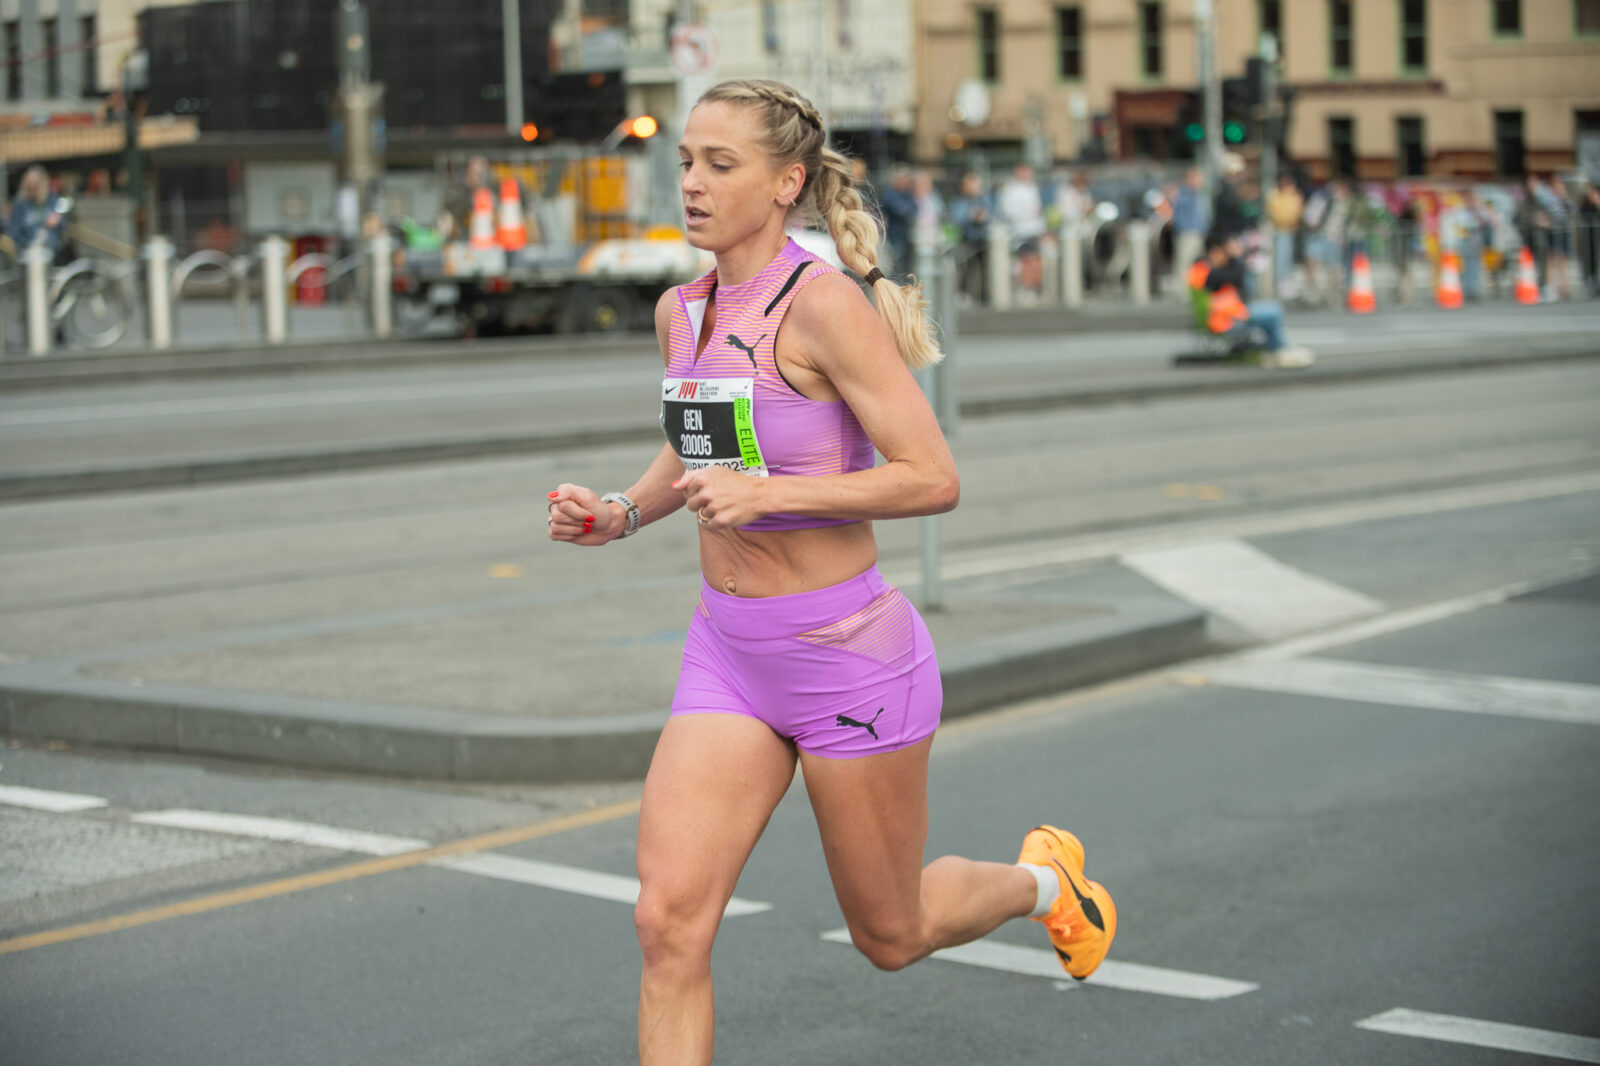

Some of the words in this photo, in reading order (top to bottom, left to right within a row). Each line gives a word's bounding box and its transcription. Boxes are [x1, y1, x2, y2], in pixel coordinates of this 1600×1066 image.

[683, 409, 704, 431] GEN
[680, 434, 713, 456] 20005
[739, 428, 761, 465] ELITE
